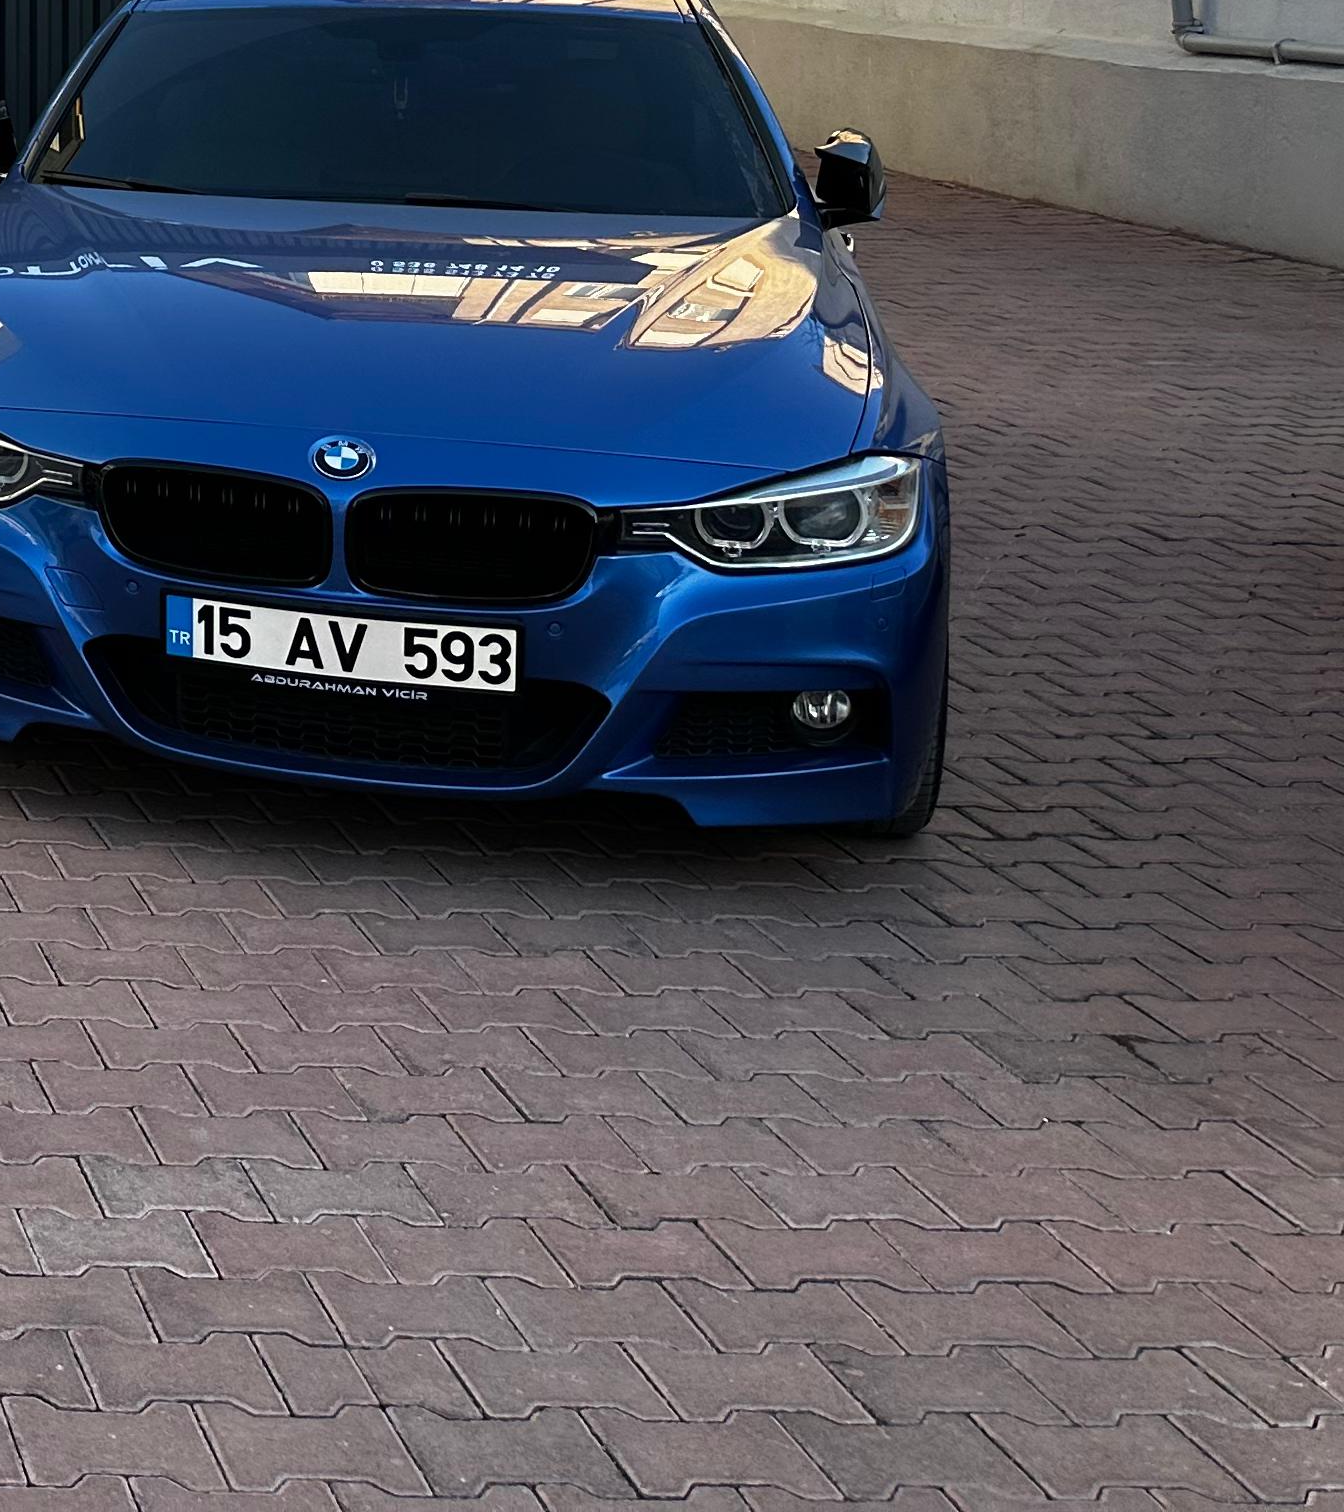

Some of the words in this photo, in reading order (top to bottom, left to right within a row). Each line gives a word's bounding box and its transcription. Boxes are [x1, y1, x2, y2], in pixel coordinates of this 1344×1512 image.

[169, 629, 191, 646] TR
[197, 604, 252, 659] 15
[285, 617, 368, 673] AV
[403, 627, 512, 685] 593
[251, 673, 377, 696] ABDURAHMAN
